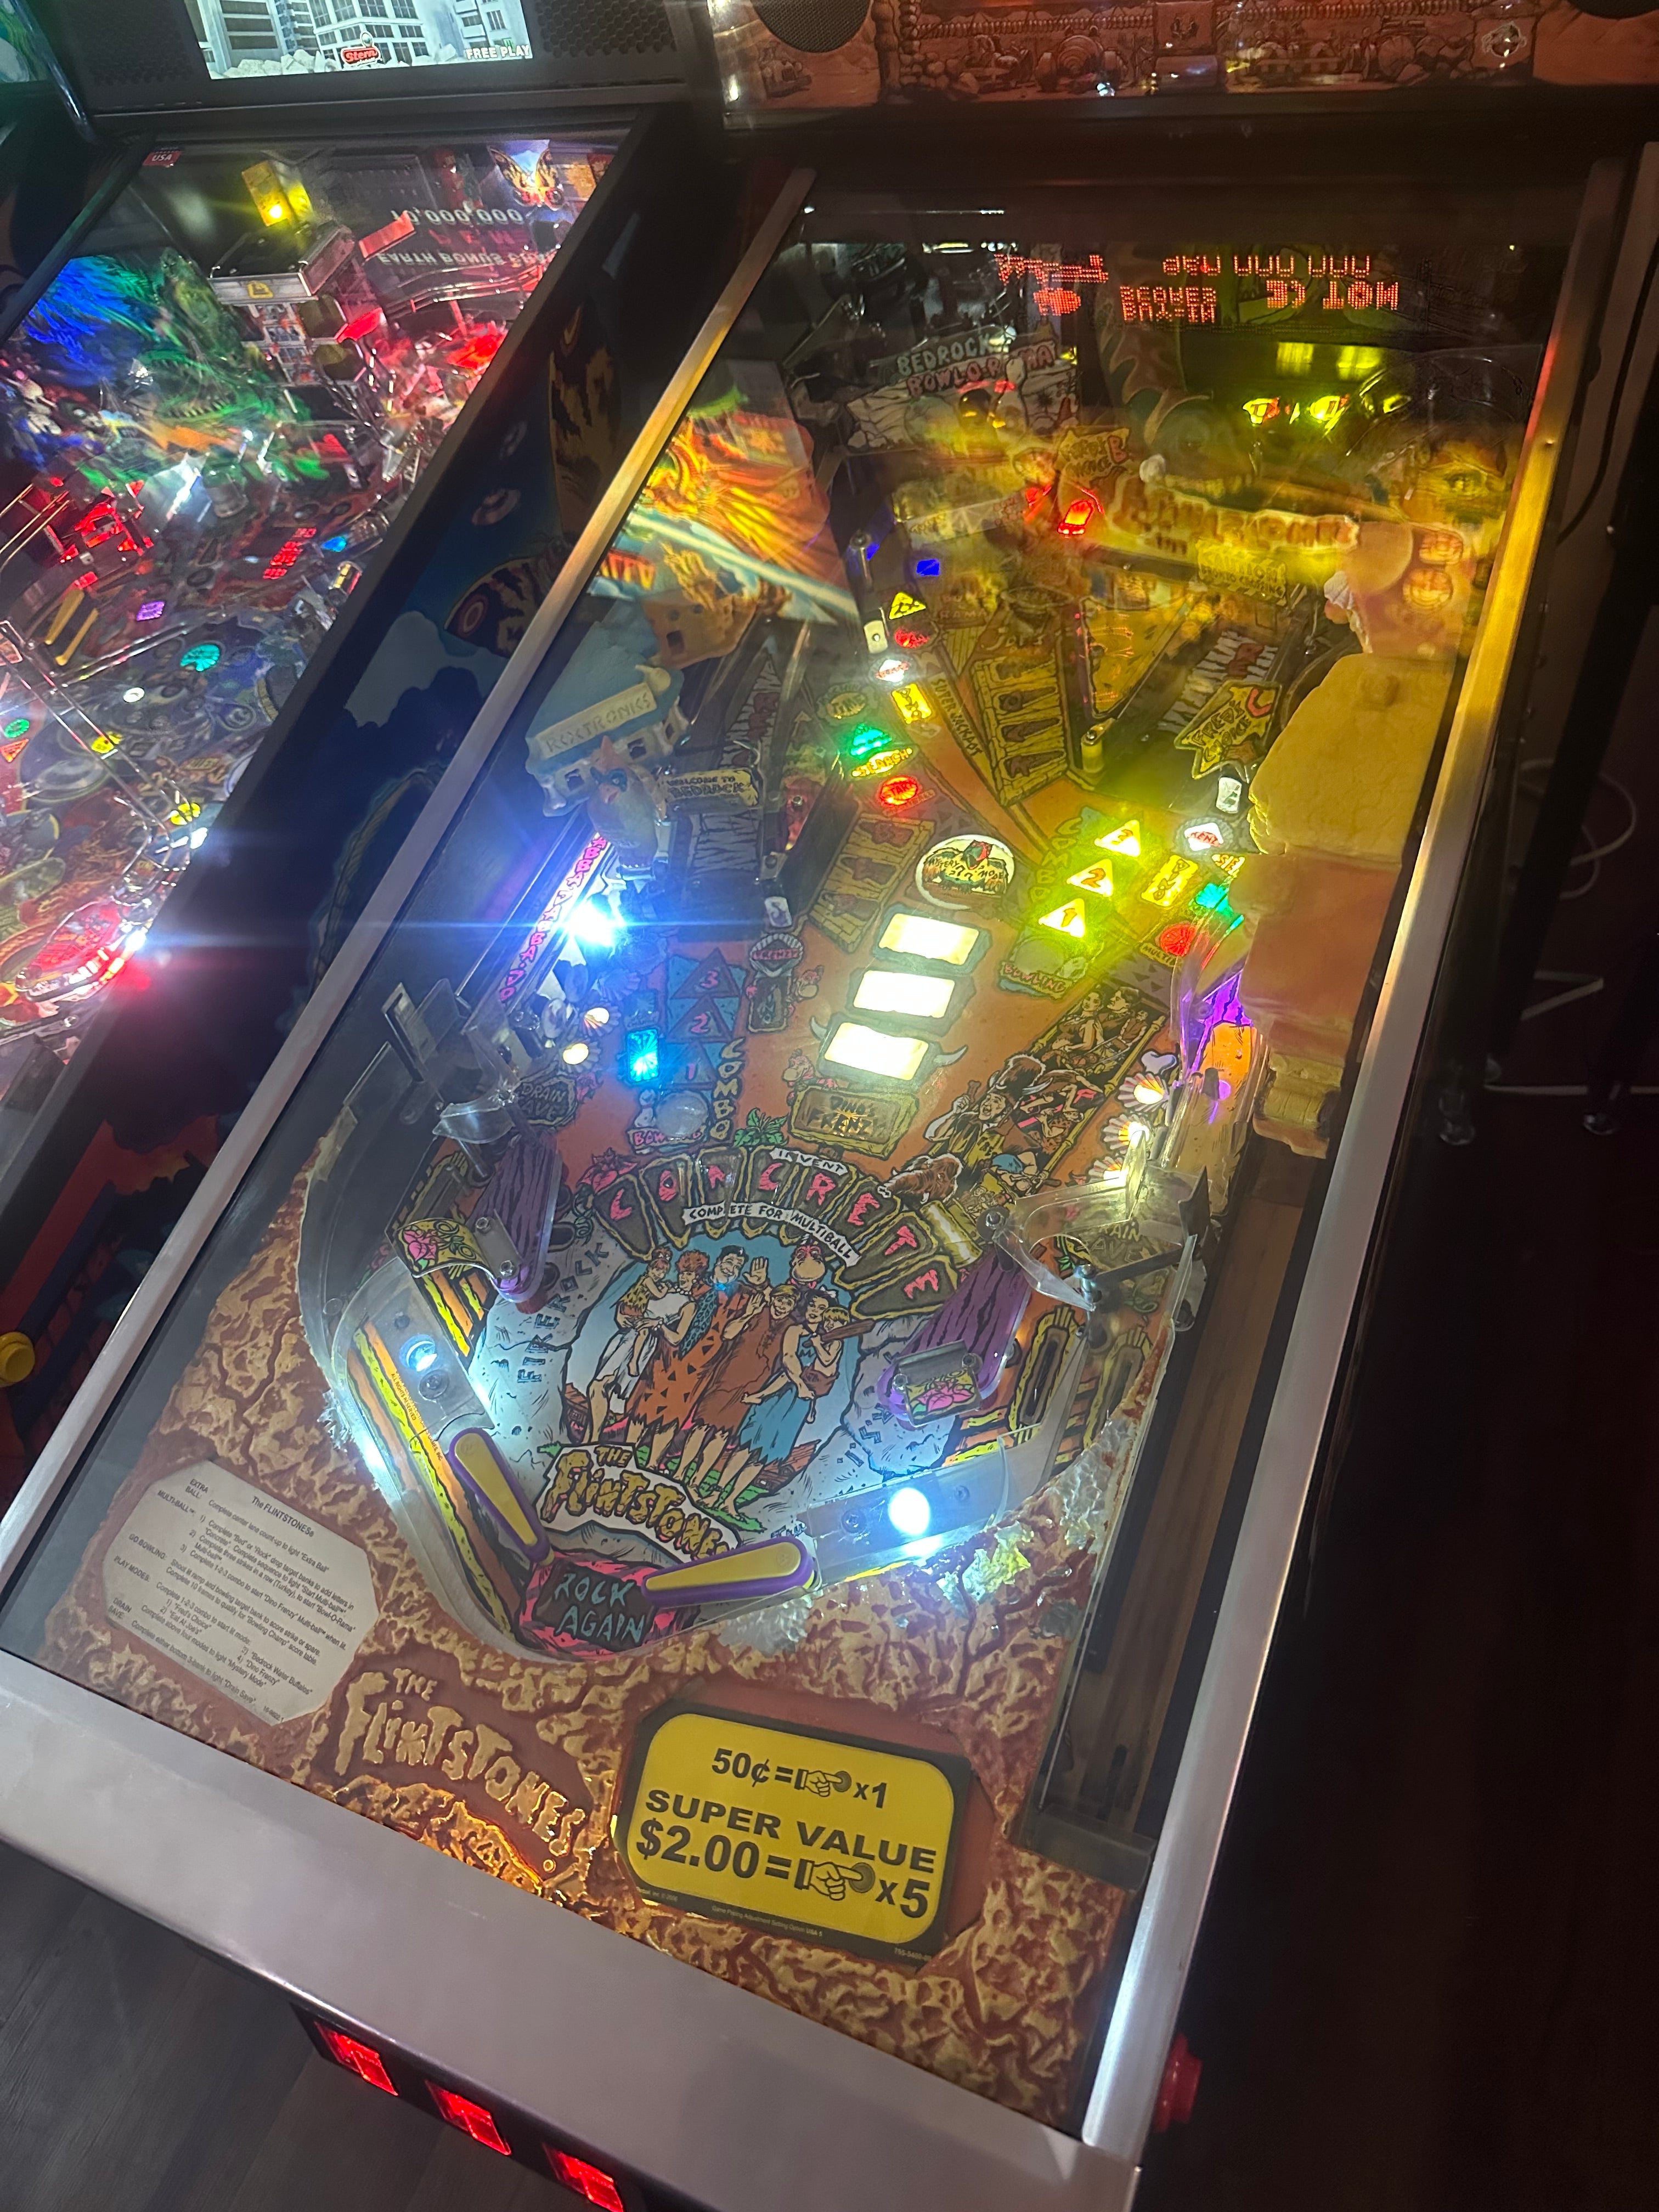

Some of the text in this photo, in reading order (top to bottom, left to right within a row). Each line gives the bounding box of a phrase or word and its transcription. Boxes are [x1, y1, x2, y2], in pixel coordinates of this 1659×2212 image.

[343, 48, 377, 64] Stern
[466, 44, 531, 60] FREE PLAY
[151, 154, 173, 162] USA
[896, 336, 989, 376] BEDROCK
[906, 343, 1055, 396] BOWL-O-RMA
[930, 678, 957, 712] SUPER
[1192, 699, 1245, 747] FRED'S
[1204, 716, 1252, 763] CHOICE
[856, 749, 909, 777] SEARCH
[667, 775, 736, 787] WELCOME TO
[668, 782, 745, 799] BEDROCK
[929, 857, 960, 869] MYSTERY
[1081, 867, 1106, 888] 2
[1061, 907, 1078, 927] 1
[701, 970, 720, 988] 3
[1002, 962, 1066, 993] BOWLING
[691, 1014, 709, 1034] 2
[686, 1063, 698, 1080] 1
[710, 1037, 747, 1140] COMBO
[522, 1084, 567, 1102] DRAIN
[689, 1205, 852, 1260] COMPETE FOR MULTIBALL
[394, 1381, 407, 1400] RIGHTS
[402, 1397, 416, 1421] RESERVED
[596, 1446, 633, 1468] THE
[184, 1486, 202, 1499] BALL:
[189, 1478, 210, 1493] EXTRA
[539, 1449, 729, 1561] FLINTSTONE
[207, 1499, 330, 1573] Complete center count-up light "Extra Ball"
[206, 1520, 349, 1606] Complete "Bed" "Rock" target banks letters
[232, 1545, 316, 1598] Complete sequence light "Start
[188, 1549, 298, 1620] Complete 1-2-3 combo start "Dino Frenzy"
[198, 1535, 224, 1554] Complete
[222, 1549, 237, 1561] three
[235, 1558, 254, 1571] strikes
[302, 1597, 316, 1609] start
[314, 1605, 356, 1633] "Bowl-O-Rama"
[555, 1572, 636, 1608] ROCK
[112, 1597, 132, 1612] DRAIN
[155, 1582, 230, 1631] Complete 1-2-3 combo start
[165, 1566, 191, 1586] Complete
[244, 1616, 269, 1635] "Bowling
[266, 1630, 290, 1647] Champ"
[287, 1644, 303, 1656] score
[172, 1603, 212, 1630] "Fred's Choice"
[213, 1586, 300, 1641] bowling target score strike
[555, 1605, 646, 1644] AGAIN
[129, 1620, 224, 1684] Complete bottom light
[139, 1605, 267, 1688] Complete above modes light "Mystery Mode"
[244, 1660, 280, 1686] "Dino Frenzy"
[249, 1652, 313, 1695] "Bedrock Water Buffalos"
[393, 1668, 438, 1701] THE
[334, 1671, 586, 1857] FLINTSTONES
[854, 1782, 888, 1809] x1
[645, 1788, 937, 1874] SUPER VALUE
[874, 1877, 932, 1918] x5
[806, 1928, 818, 1936] USA
